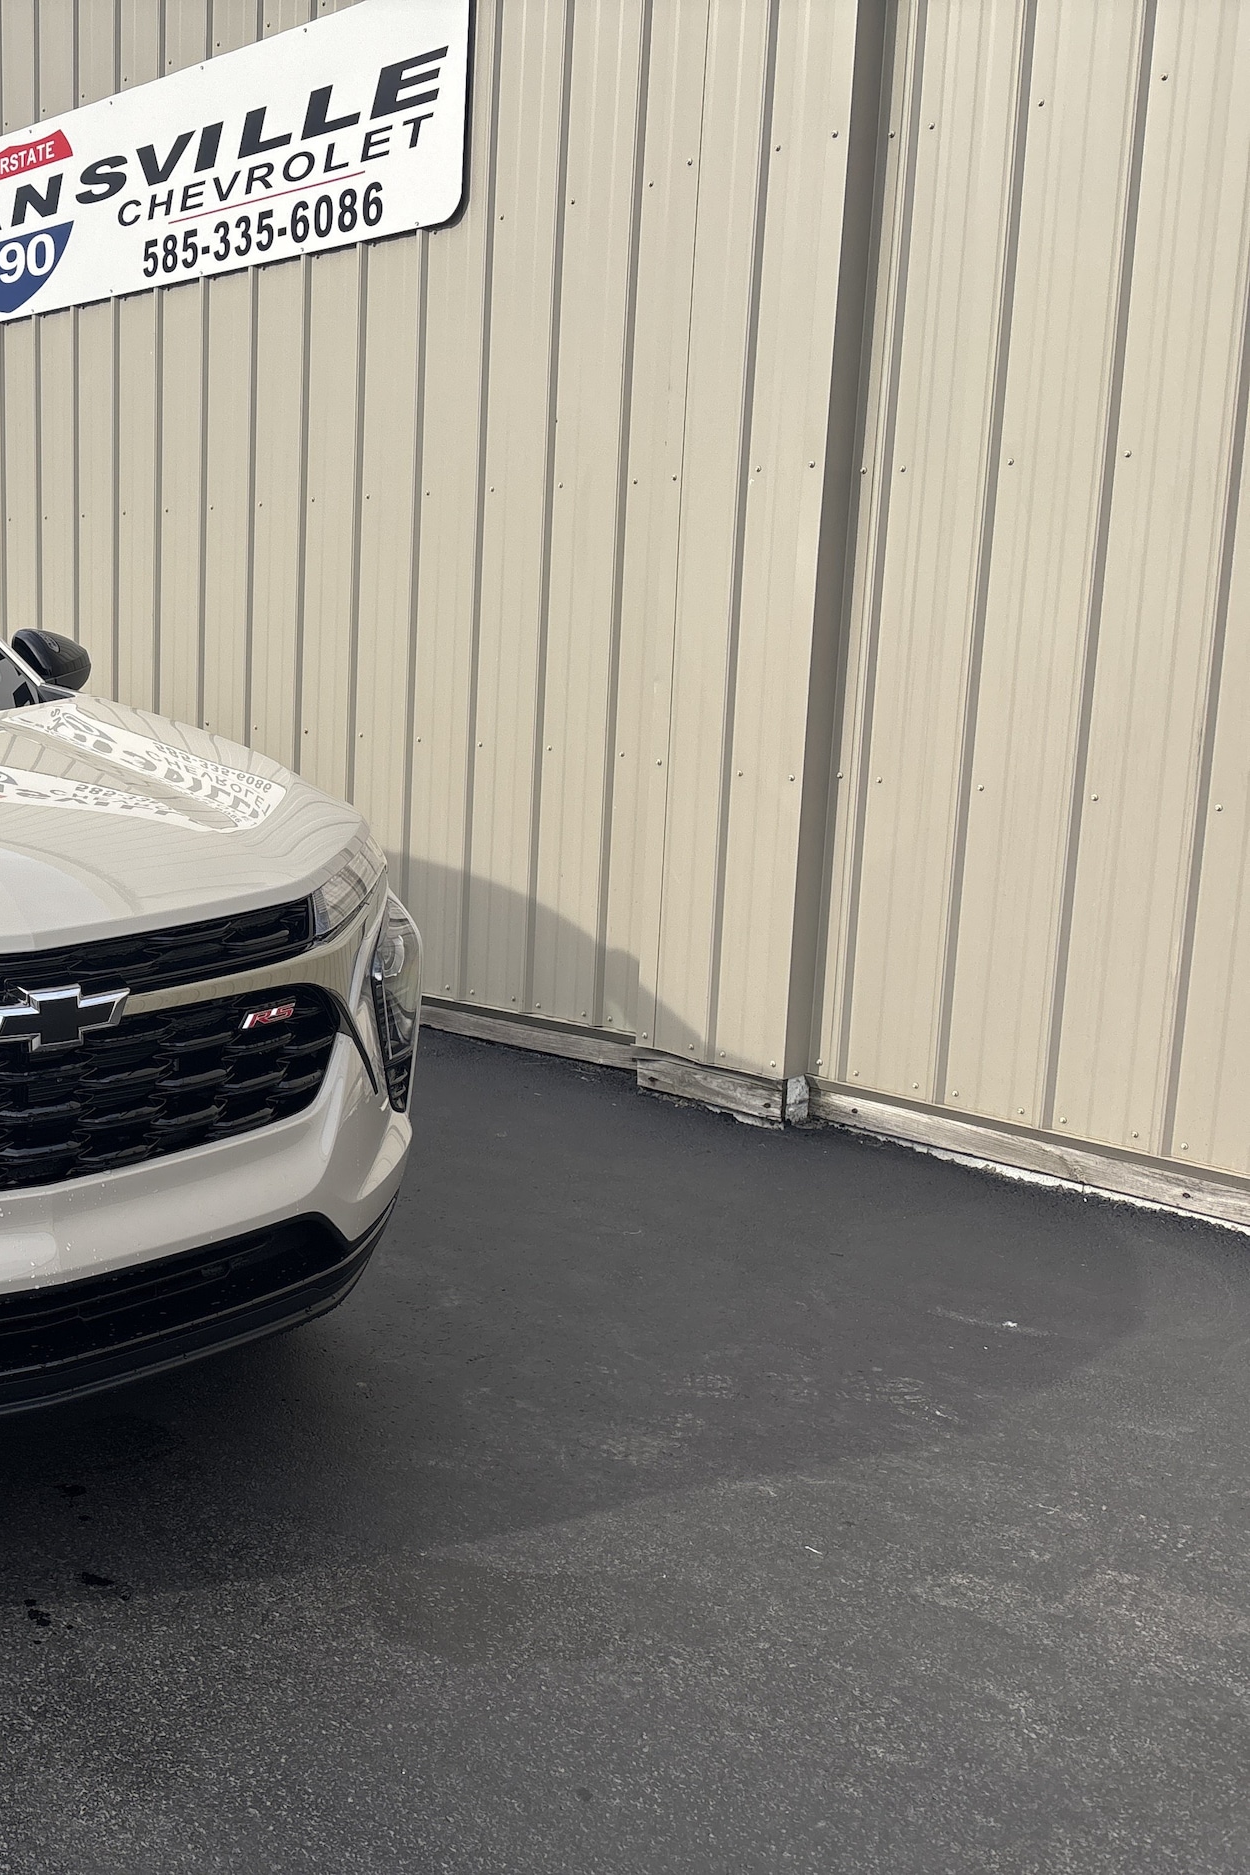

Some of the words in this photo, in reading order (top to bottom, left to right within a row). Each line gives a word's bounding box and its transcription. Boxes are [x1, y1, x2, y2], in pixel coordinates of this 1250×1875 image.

[117, 111, 434, 227] CHEVROLET
[143, 181, 383, 277] 585-335-6086
[242, 1002, 296, 1029] RS
